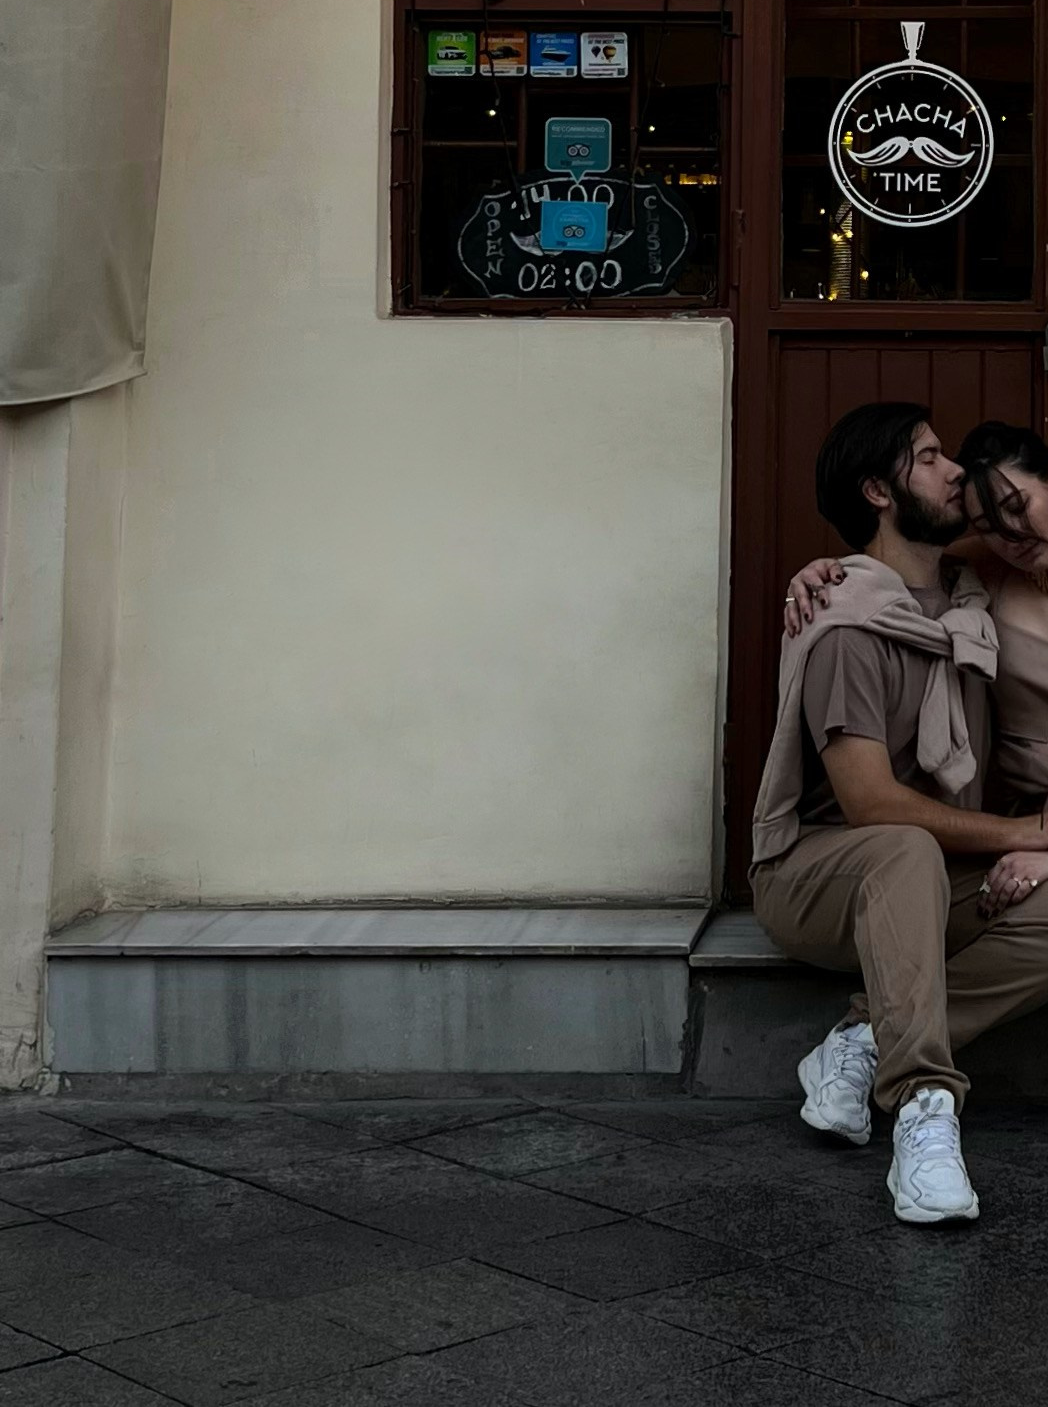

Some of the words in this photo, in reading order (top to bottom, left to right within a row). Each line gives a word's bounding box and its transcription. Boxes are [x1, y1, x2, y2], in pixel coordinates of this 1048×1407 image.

[855, 102, 967, 139] CHACHA
[879, 172, 942, 193] TIME
[484, 200, 504, 278] OPEN
[517, 259, 623, 292] 02:00
